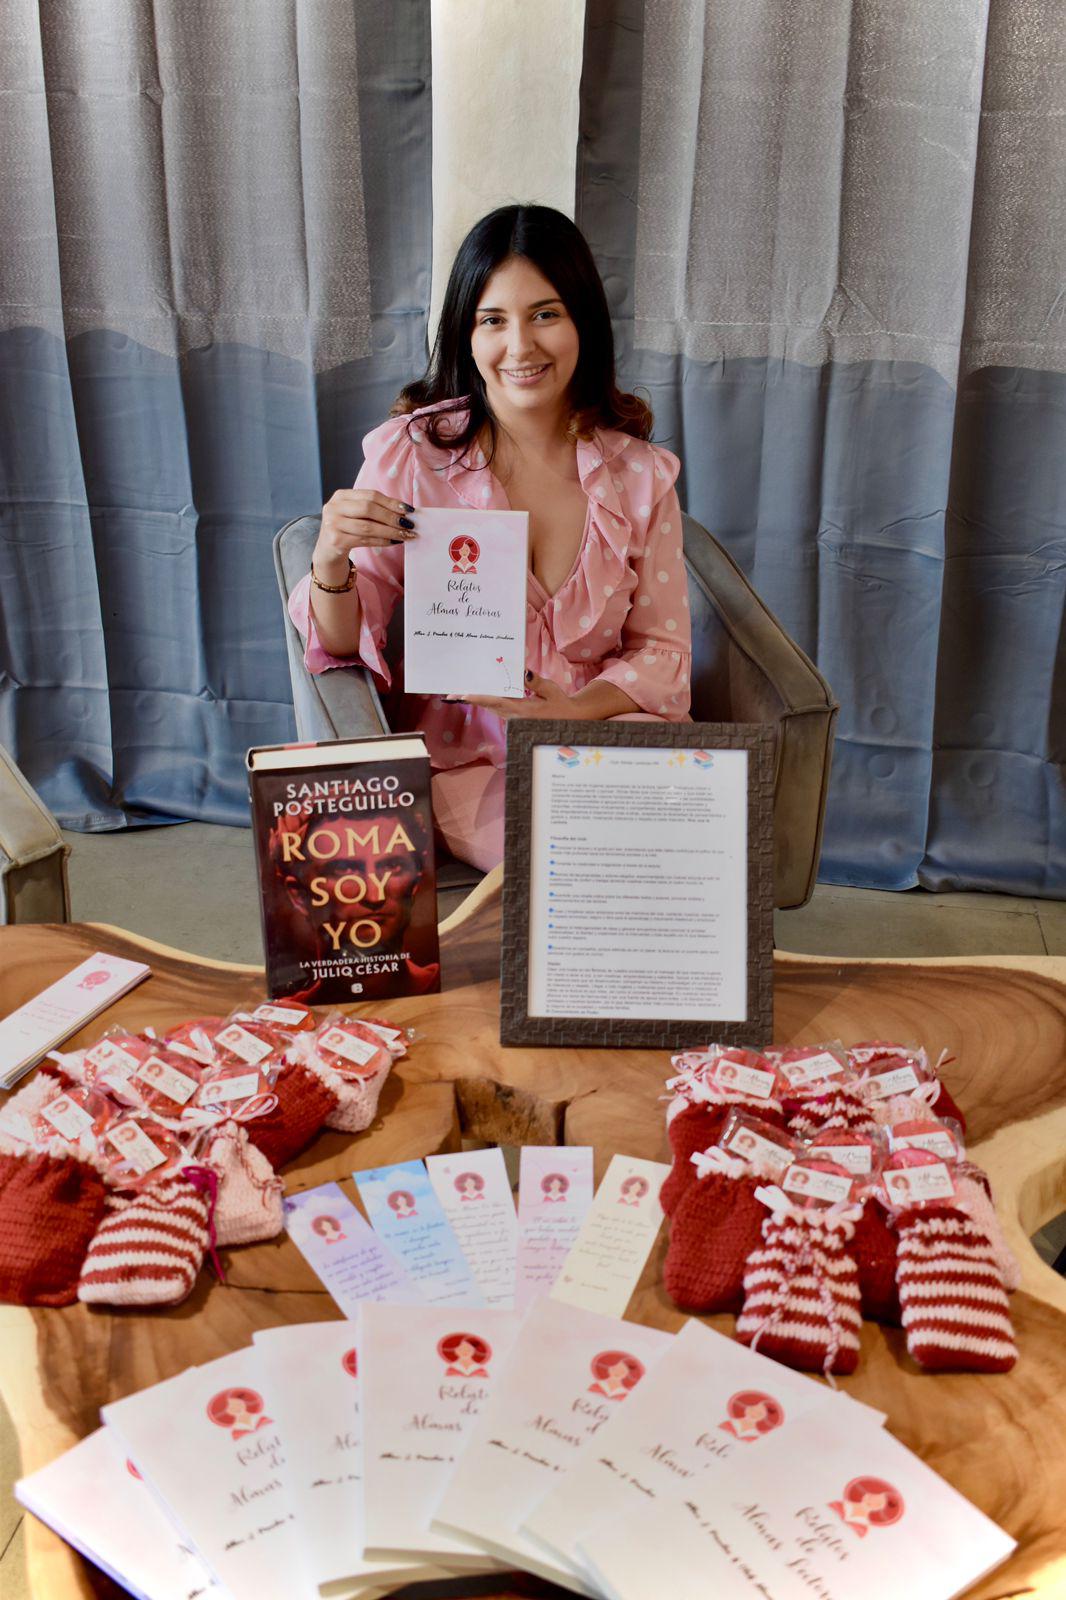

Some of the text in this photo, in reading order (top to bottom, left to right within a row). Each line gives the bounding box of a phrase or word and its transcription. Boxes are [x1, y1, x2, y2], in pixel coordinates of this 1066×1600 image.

[447, 579, 481, 592] Relatos
[458, 591, 469, 603] de
[427, 602, 501, 617] Almas Lectoras
[286, 776, 399, 799] SANTIAGO
[273, 792, 415, 817] POSTEGUILLO
[281, 824, 417, 862] ROMA
[310, 872, 392, 906] SOY
[322, 919, 382, 950] YO
[311, 957, 360, 968] VERDADERA
[361, 953, 399, 963] HISTORIA
[355, 962, 399, 975] CÉSAR
[438, 1384, 488, 1400] Relat
[407, 1413, 463, 1432] Almas
[529, 1415, 582, 1447] Almas
[236, 1435, 283, 1466] Relat
[229, 1479, 283, 1507] Almas
[795, 1506, 849, 1561] Relatos
[739, 1503, 782, 1550] Almas
[786, 1558, 834, 1600] Lector
